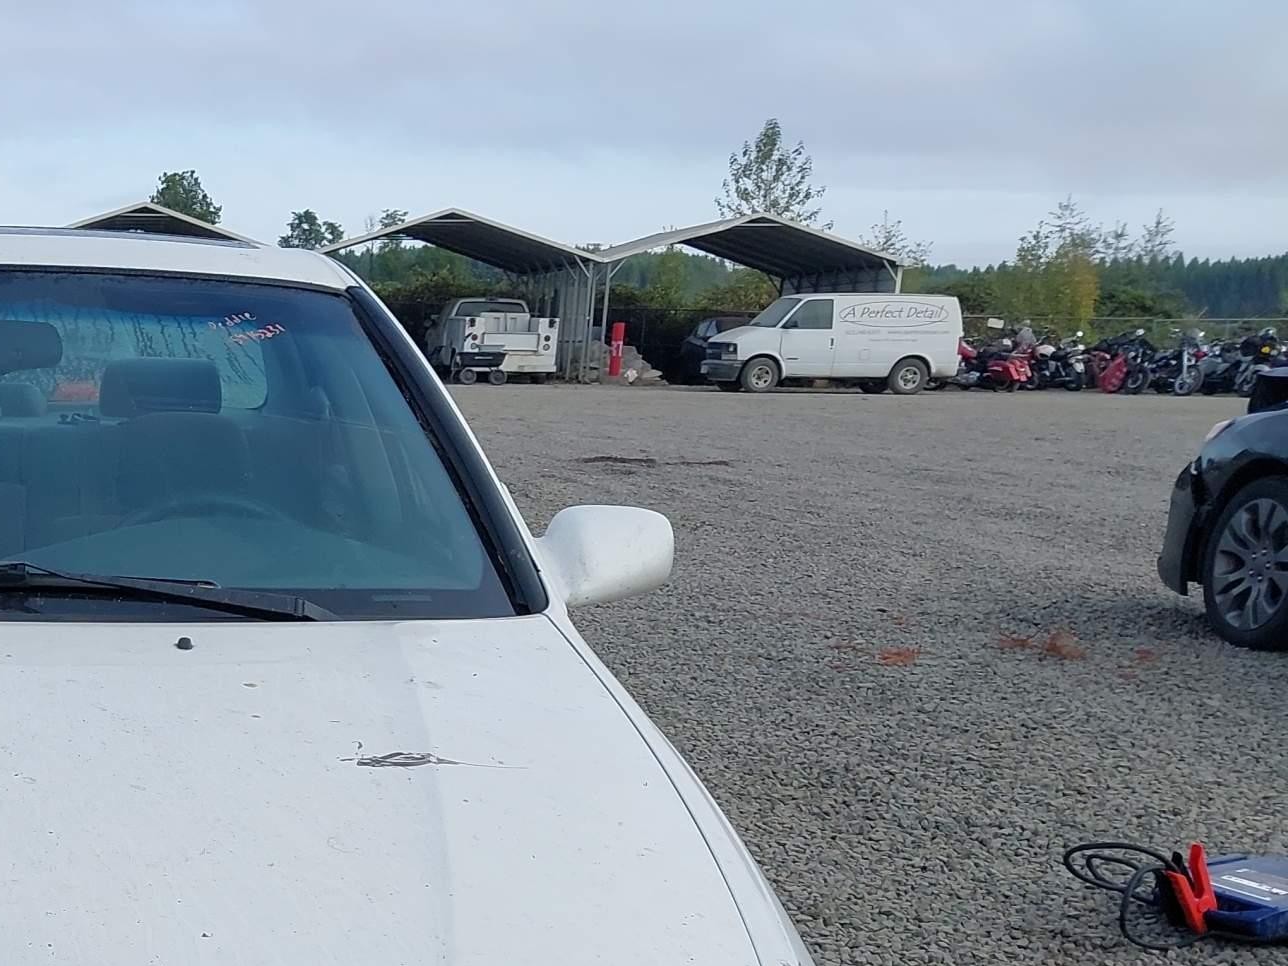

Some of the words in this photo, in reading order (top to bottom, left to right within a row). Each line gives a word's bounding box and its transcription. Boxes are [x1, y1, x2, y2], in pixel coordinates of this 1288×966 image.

[843, 306, 856, 319] A
[860, 304, 904, 319] Perfect
[907, 305, 944, 319] Detail
